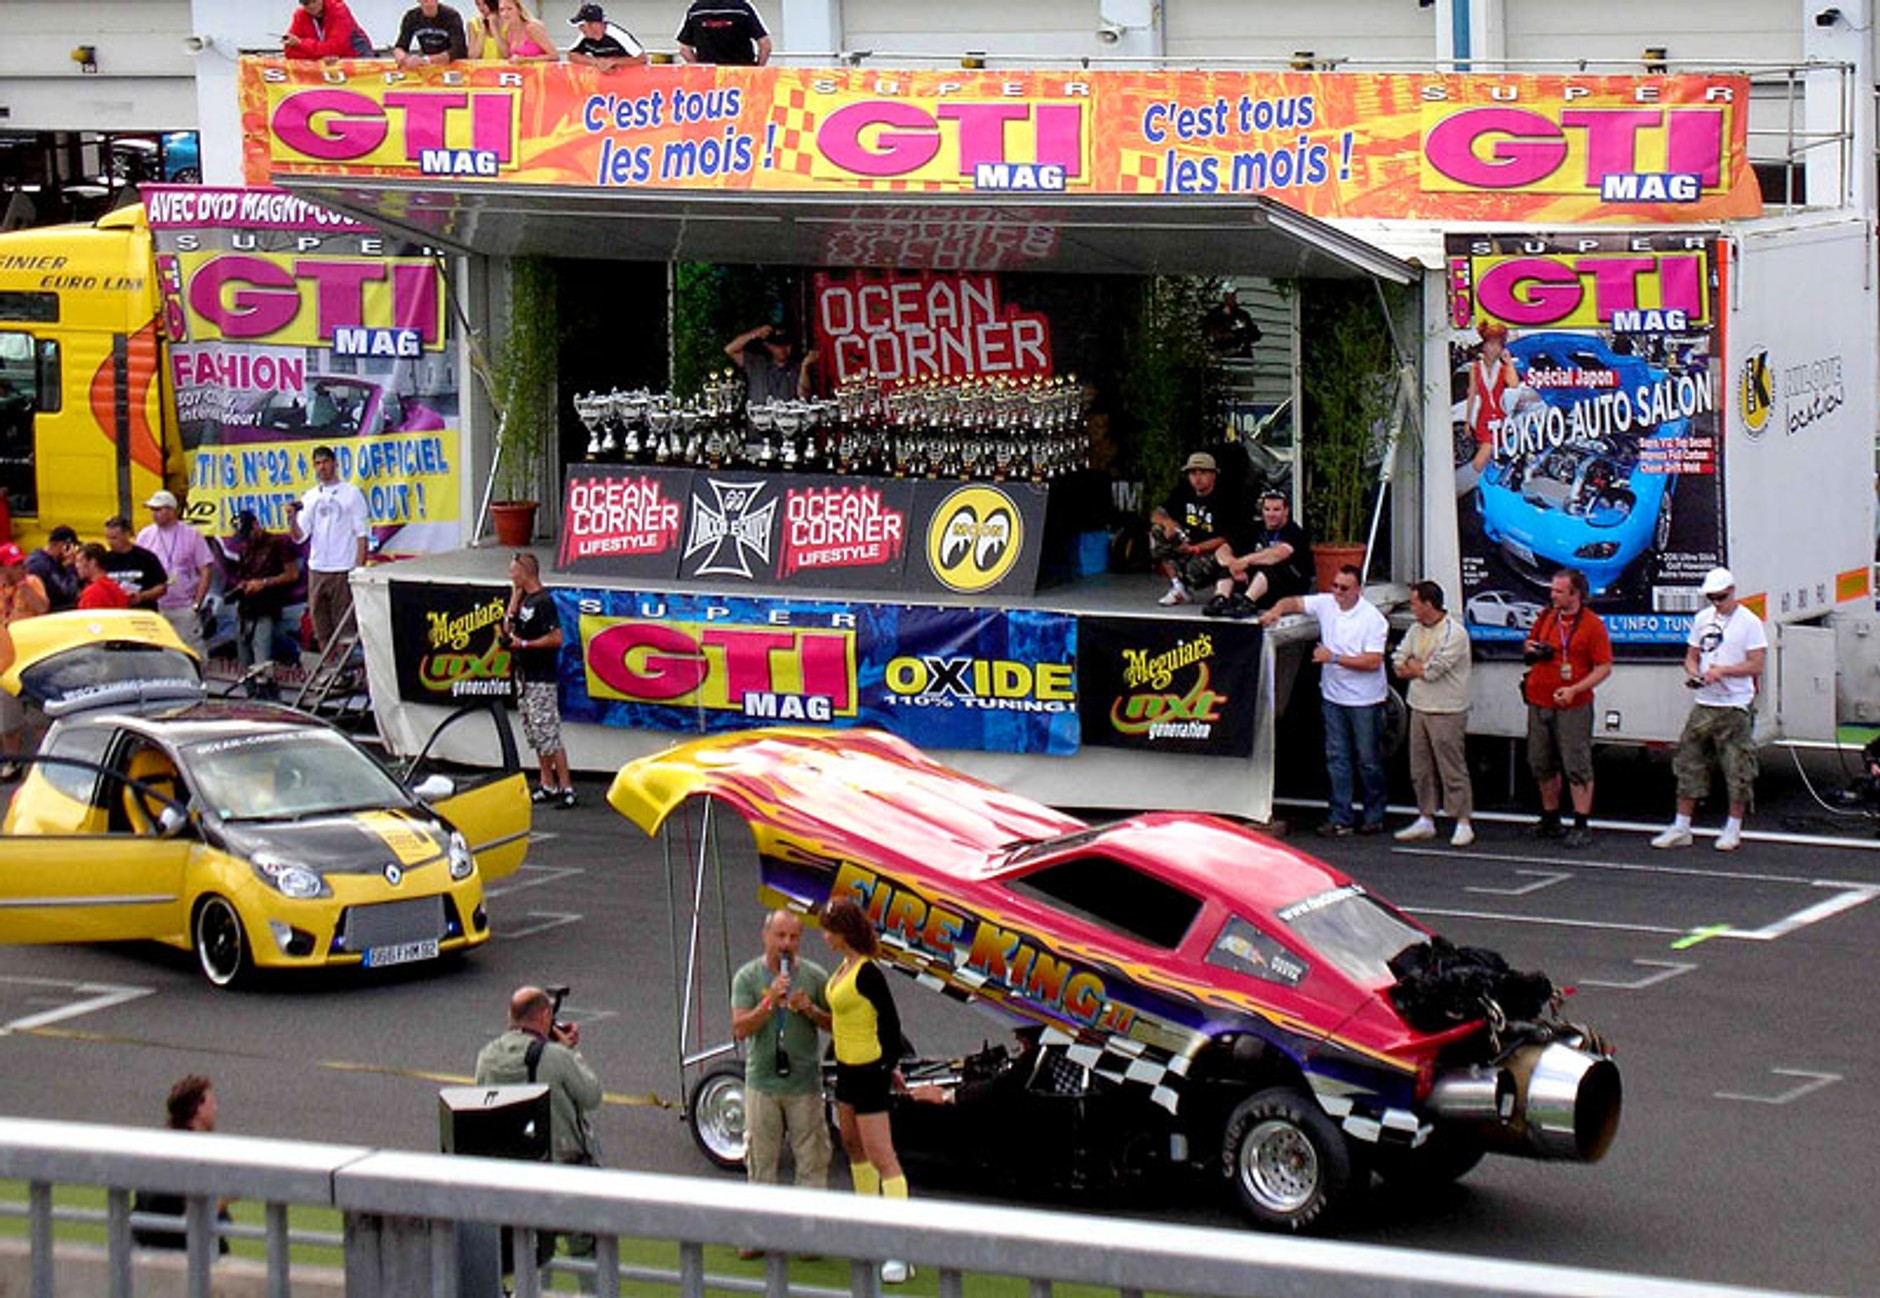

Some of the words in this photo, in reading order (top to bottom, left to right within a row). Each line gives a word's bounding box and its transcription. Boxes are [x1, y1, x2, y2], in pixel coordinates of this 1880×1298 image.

[263, 68, 523, 87] SUPER
[814, 79, 1090, 97] SUPER
[1421, 85, 1734, 101] SUPER
[584, 90, 663, 131] C'est
[671, 87, 741, 124] tous
[1144, 98, 1228, 142] C'est
[1239, 96, 1314, 133] tous
[271, 89, 513, 163] GTI
[816, 100, 1081, 177] GTI
[422, 151, 498, 174] MAG
[599, 138, 652, 185] les
[660, 126, 753, 180] mois
[1425, 107, 1722, 188] GTI
[977, 165, 1065, 190] MAG
[1165, 148, 1219, 193] les
[1231, 135, 1328, 191] mois
[1603, 175, 1699, 200] MAG
[149, 193, 197, 222] AVEC
[198, 193, 238, 220] DVD
[1472, 237, 1705, 254] SUPER
[188, 254, 438, 343] GTI
[821, 277, 995, 336] OCEAN
[1476, 257, 1701, 325] GTI
[1614, 310, 1687, 332] MAG
[337, 329, 420, 356] MAG
[834, 319, 1047, 380] CORNER
[1526, 366, 1574, 388] Spécial
[1576, 367, 1615, 389] Japon
[1487, 405, 1565, 460] TOKYO
[1570, 390, 1632, 441] AUTO
[1637, 370, 1713, 427] SALON
[357, 437, 449, 479] OFFICIEL
[571, 483, 659, 511] OCEAN
[789, 492, 880, 521] OCEAN
[573, 503, 679, 535] CORNER
[791, 514, 902, 546] CORNER
[579, 534, 658, 555] LIFESTYLE
[798, 543, 880, 566] LIFESTYLE
[425, 597, 505, 650] Meguiar's
[578, 599, 856, 628] SUPER
[1610, 615, 1659, 632] L'INFO
[587, 622, 849, 709] GTI
[884, 655, 1076, 700] OXIDE
[1122, 633, 1215, 690] Meguiar's
[744, 693, 831, 721] MAG
[884, 694, 955, 709] 110%
[831, 860, 966, 964] FIRE
[966, 920, 1106, 1023] KING
